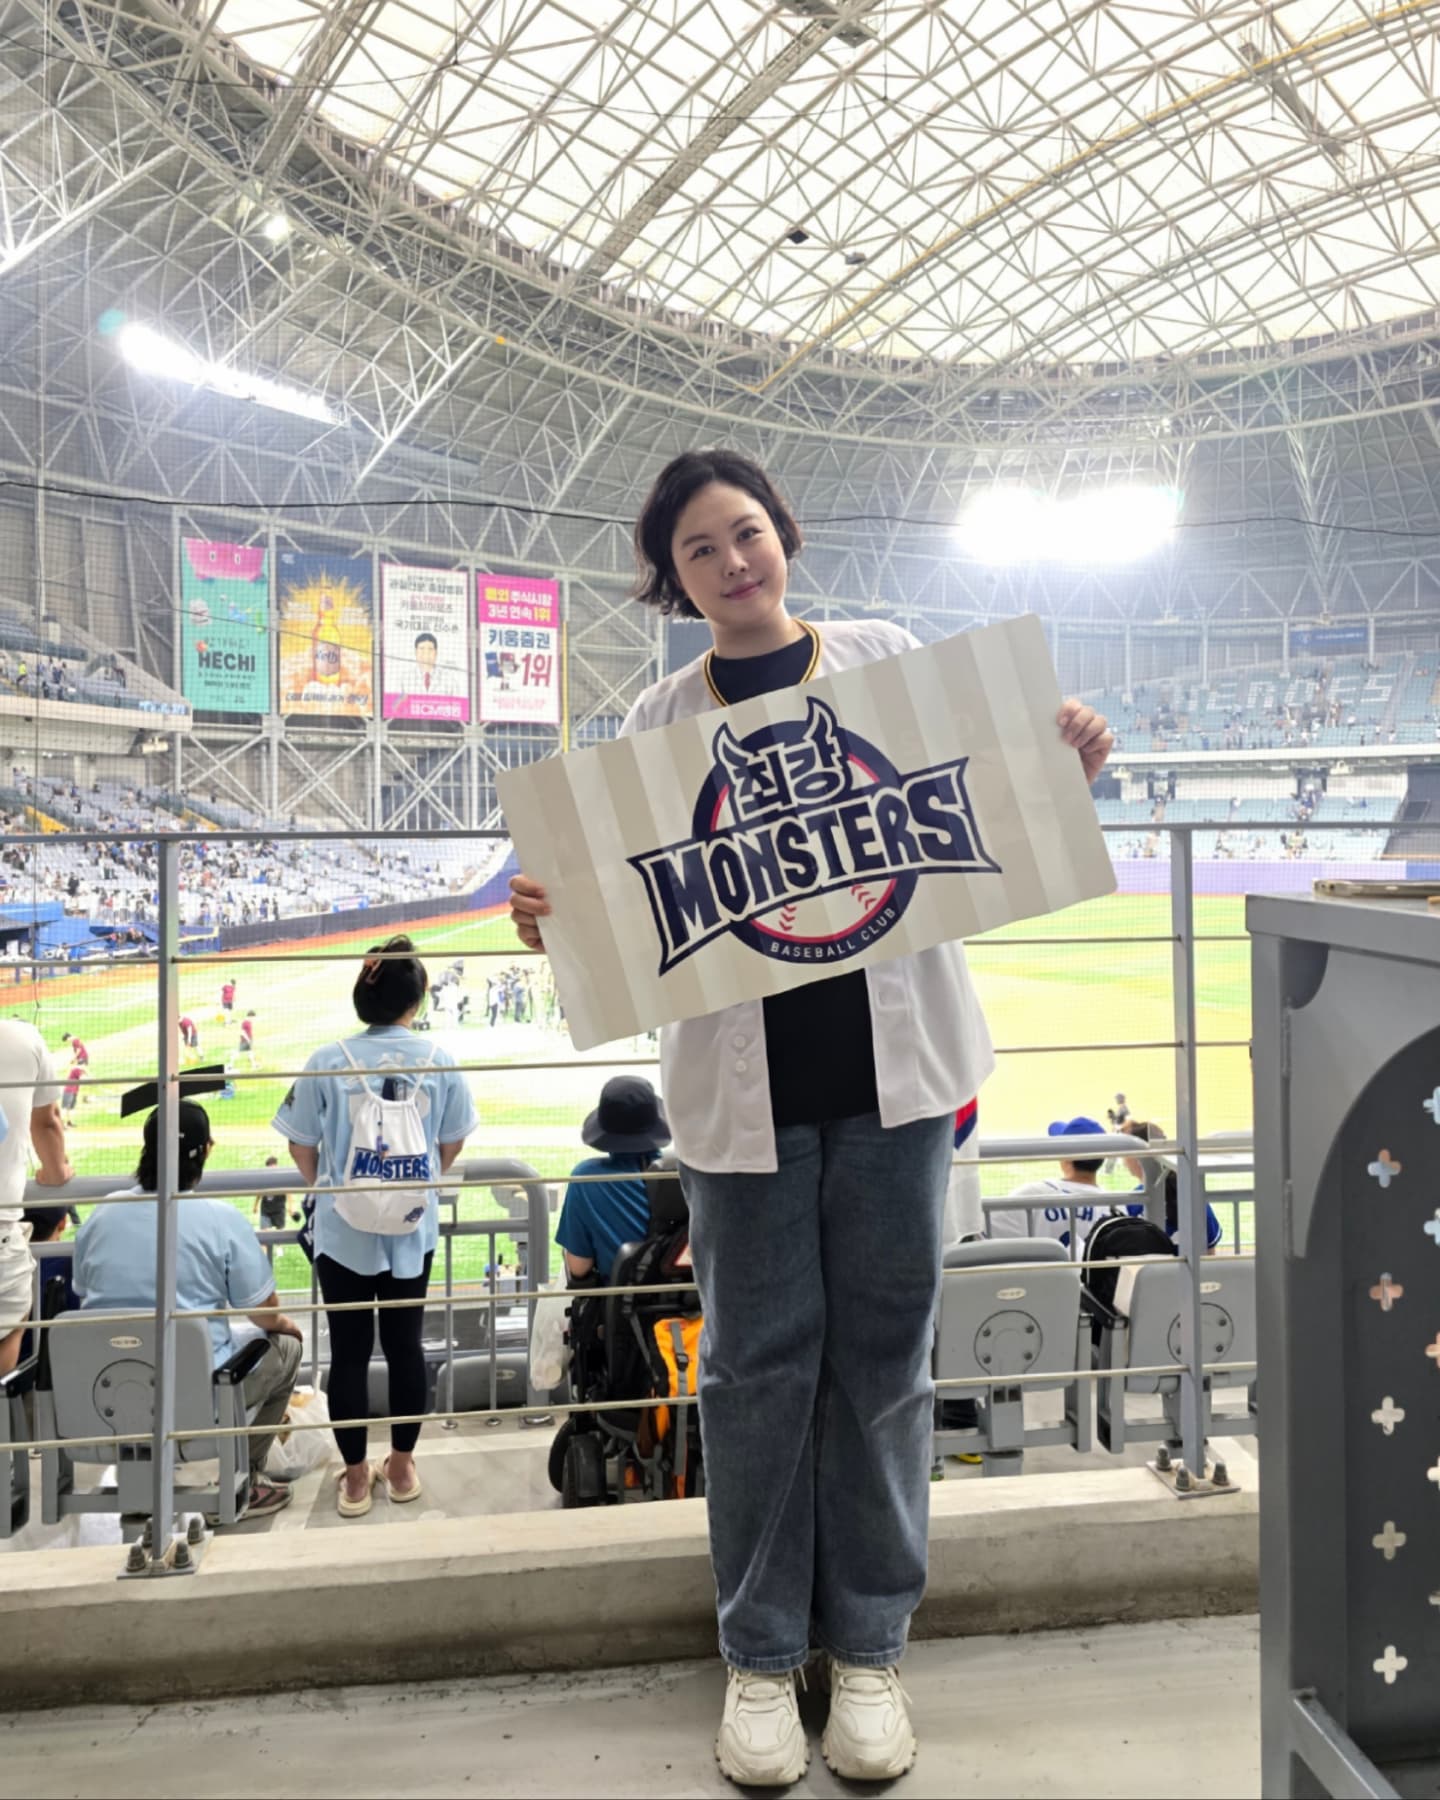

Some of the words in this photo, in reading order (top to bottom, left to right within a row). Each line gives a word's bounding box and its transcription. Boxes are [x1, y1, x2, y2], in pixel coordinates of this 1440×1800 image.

[488, 604, 507, 618] 3년
[510, 606, 532, 620] 연속
[488, 629, 550, 649] 키움증권
[198, 651, 256, 672] HECHI
[521, 653, 552, 687] 1위
[717, 708, 846, 816] 최강
[649, 773, 977, 951] MONSTERS
[770, 940, 856, 958] BASEBALL
[860, 907, 896, 941] CLUB
